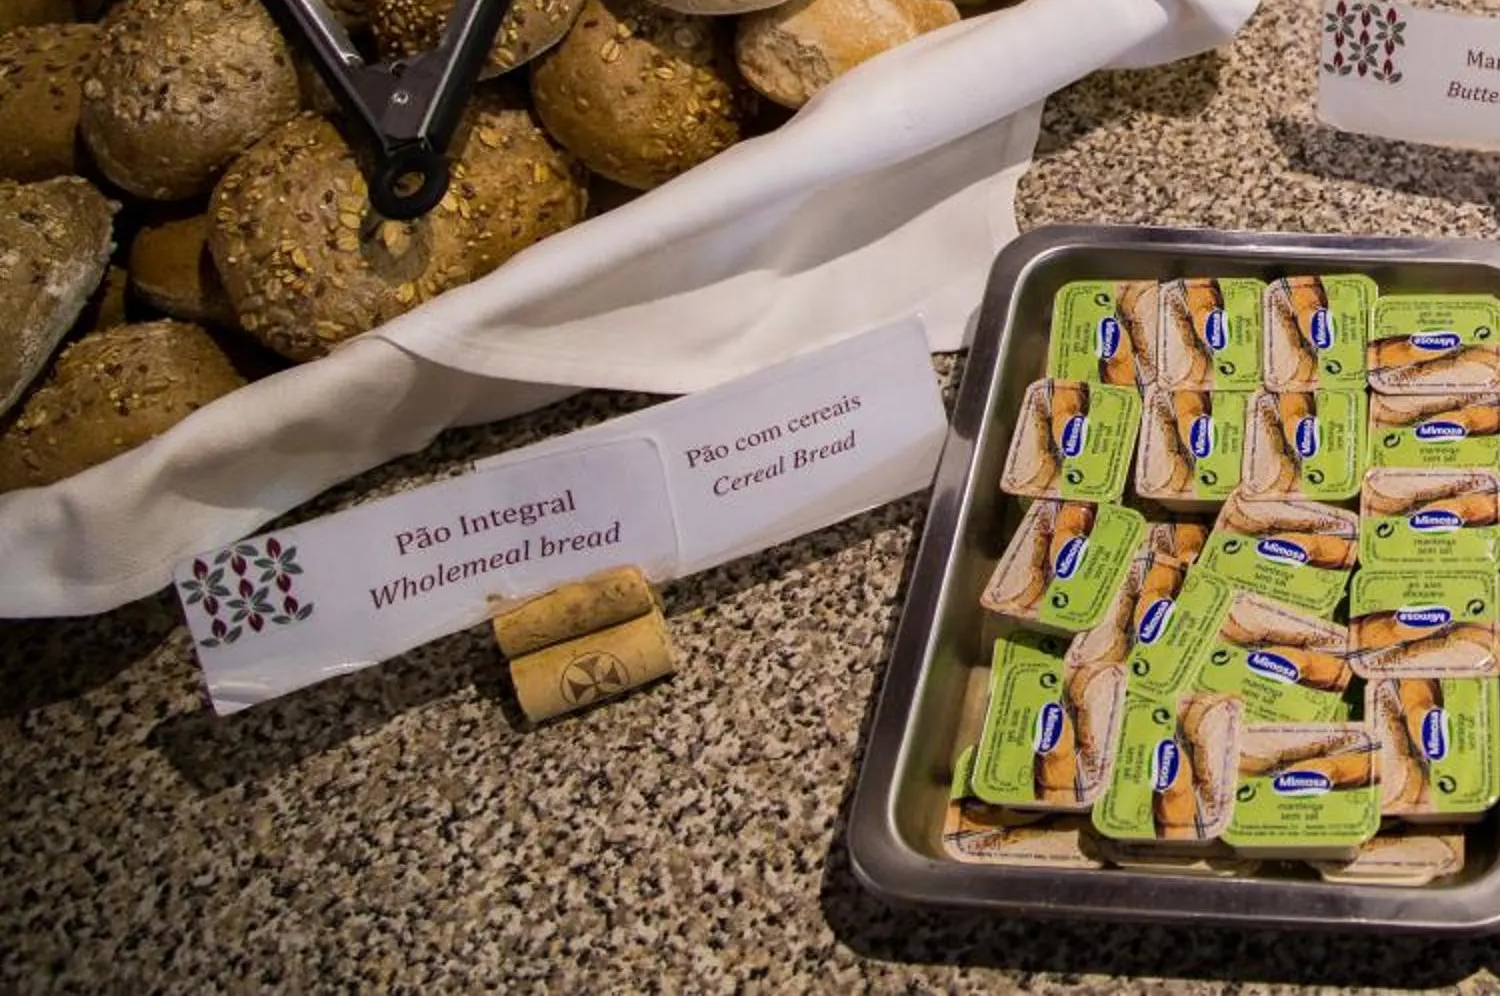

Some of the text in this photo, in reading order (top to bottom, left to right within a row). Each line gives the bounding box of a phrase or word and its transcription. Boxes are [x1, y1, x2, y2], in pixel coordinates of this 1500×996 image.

[686, 395, 862, 468] Pão com cereais
[1420, 425, 1462, 434] Mimosa
[713, 429, 857, 497] Cereal Bread
[395, 490, 577, 555] Pão Integral
[1415, 515, 1459, 524] Mimosa
[369, 521, 622, 610] Wholemeal bread
[1262, 539, 1305, 561] Mimosa
[1140, 599, 1169, 640] Mimosa
[1400, 613, 1444, 621] Mimosa
[1251, 653, 1297, 678] Mimosa
[1040, 706, 1059, 750] Mimosa
[1427, 711, 1440, 755] Mimosa
[1158, 743, 1174, 787] Mimosa
[1279, 776, 1326, 786] Mimosa
